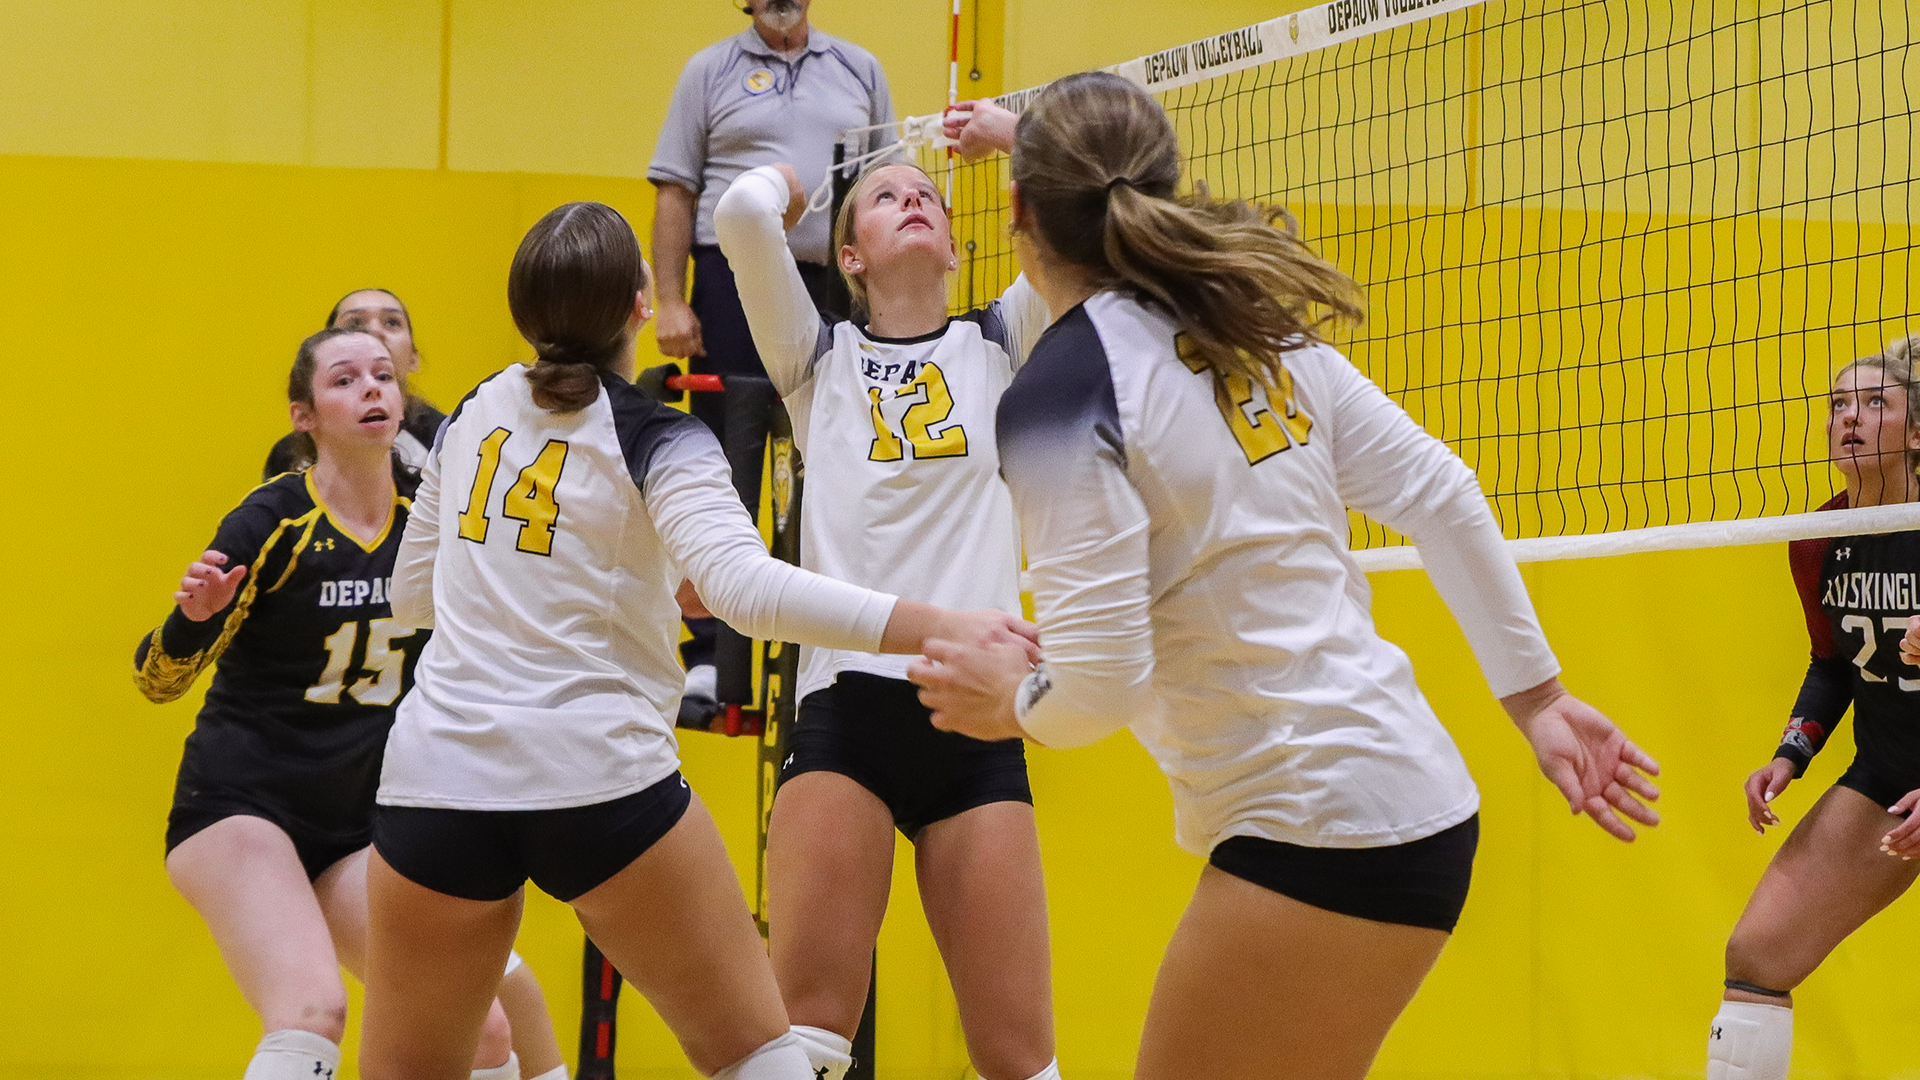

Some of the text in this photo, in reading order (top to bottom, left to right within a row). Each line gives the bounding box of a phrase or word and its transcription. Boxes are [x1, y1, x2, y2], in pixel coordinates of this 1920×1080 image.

[1327, 0, 1379, 35] DEPAUW
[1144, 25, 1263, 85] DEPAUW VOLLEYBALL
[861, 357, 928, 385] EPA
[867, 361, 969, 462] 12
[458, 426, 570, 557] 14
[304, 617, 417, 706] 15
